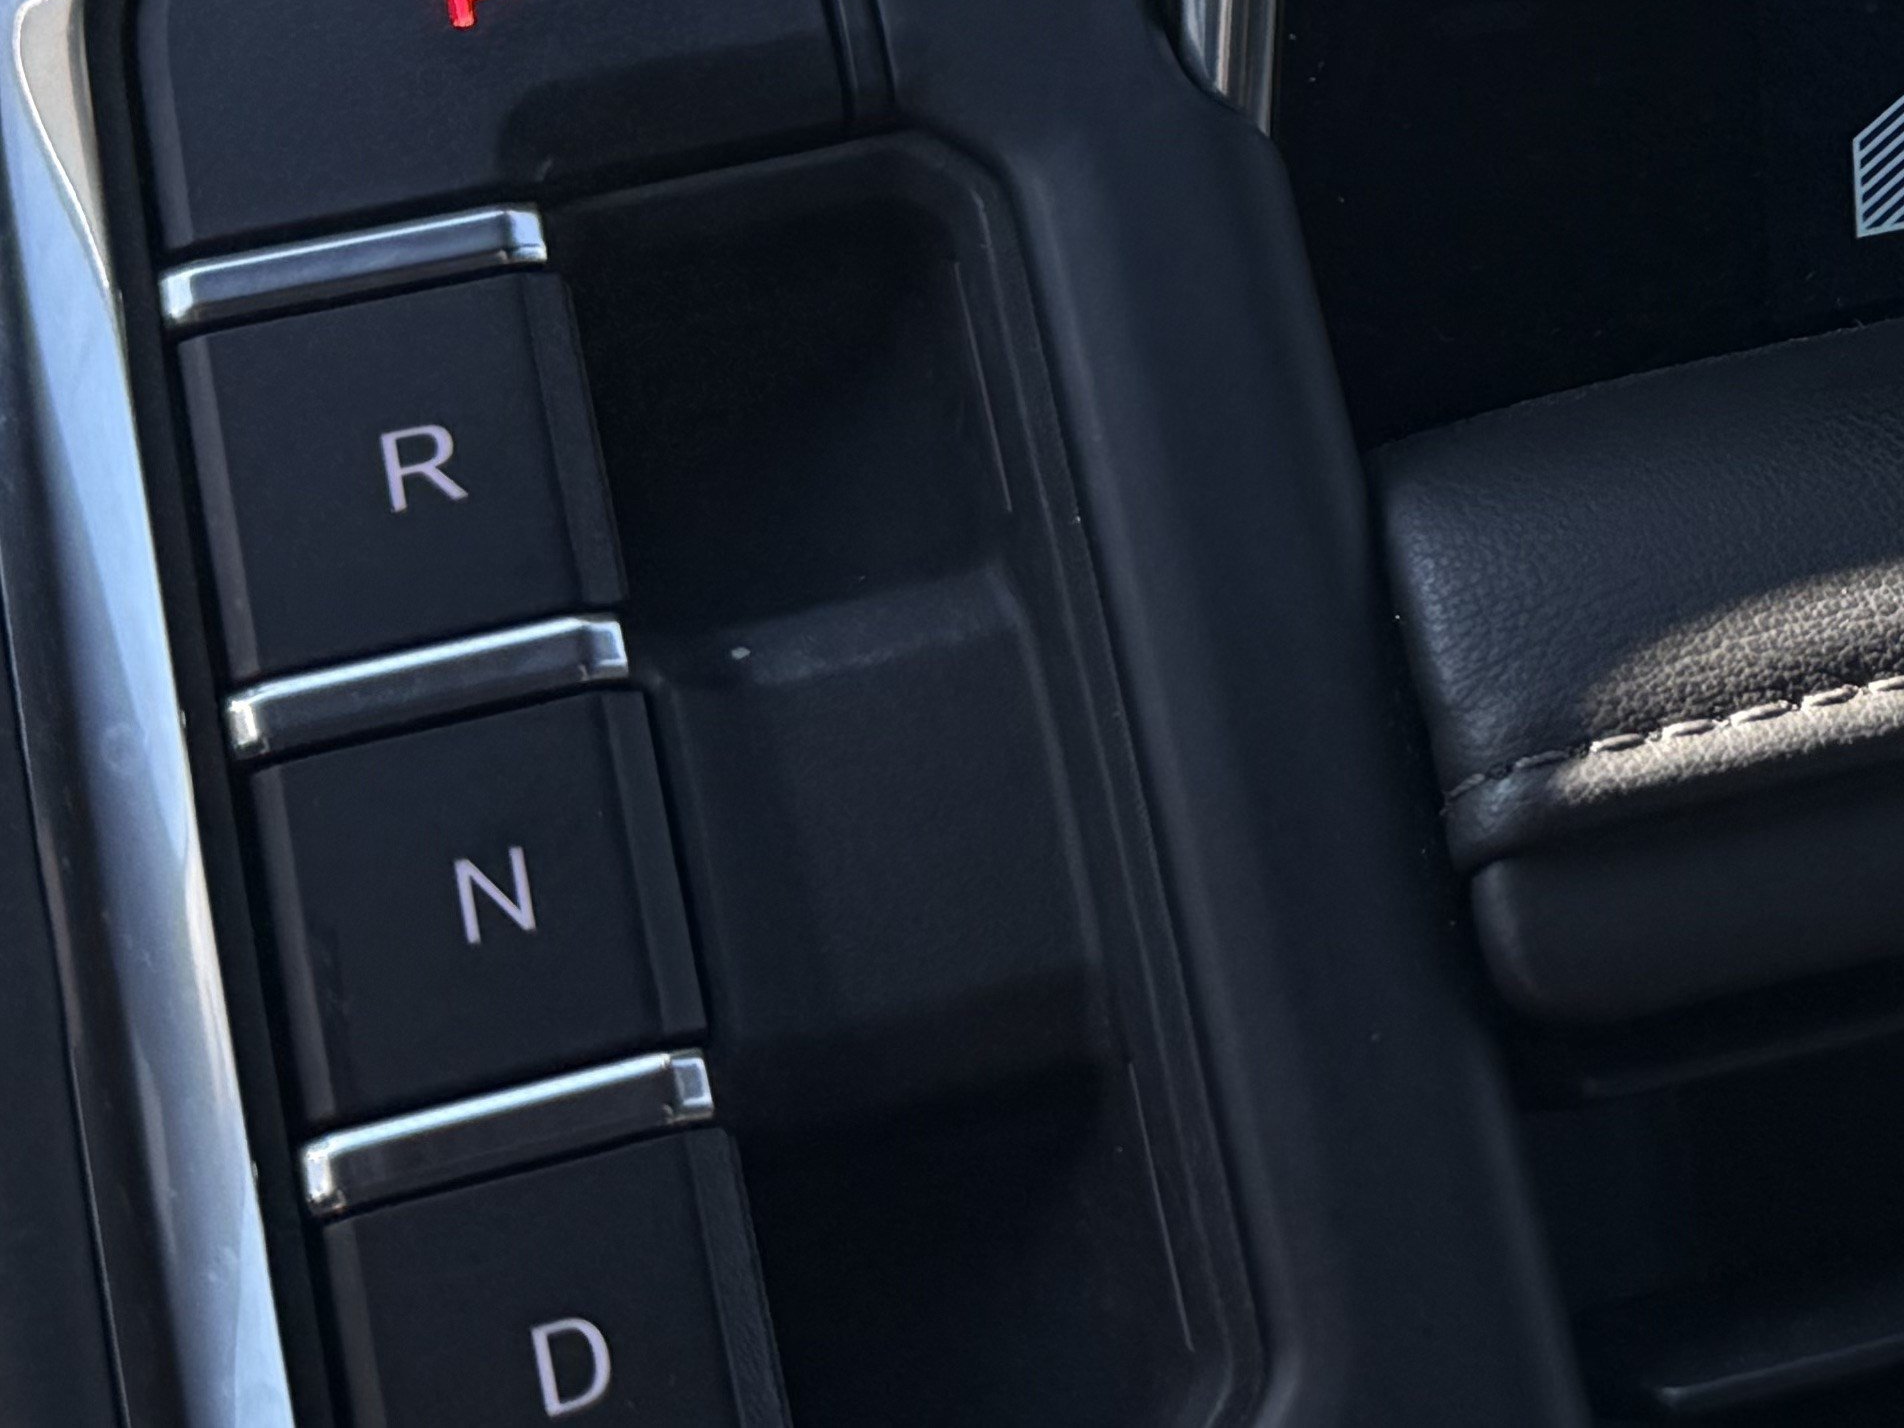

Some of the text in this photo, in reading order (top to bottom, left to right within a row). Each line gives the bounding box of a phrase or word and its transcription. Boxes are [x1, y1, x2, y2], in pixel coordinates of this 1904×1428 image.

[379, 423, 469, 513] R
[453, 845, 537, 944] N
[530, 1317, 612, 1417] D
